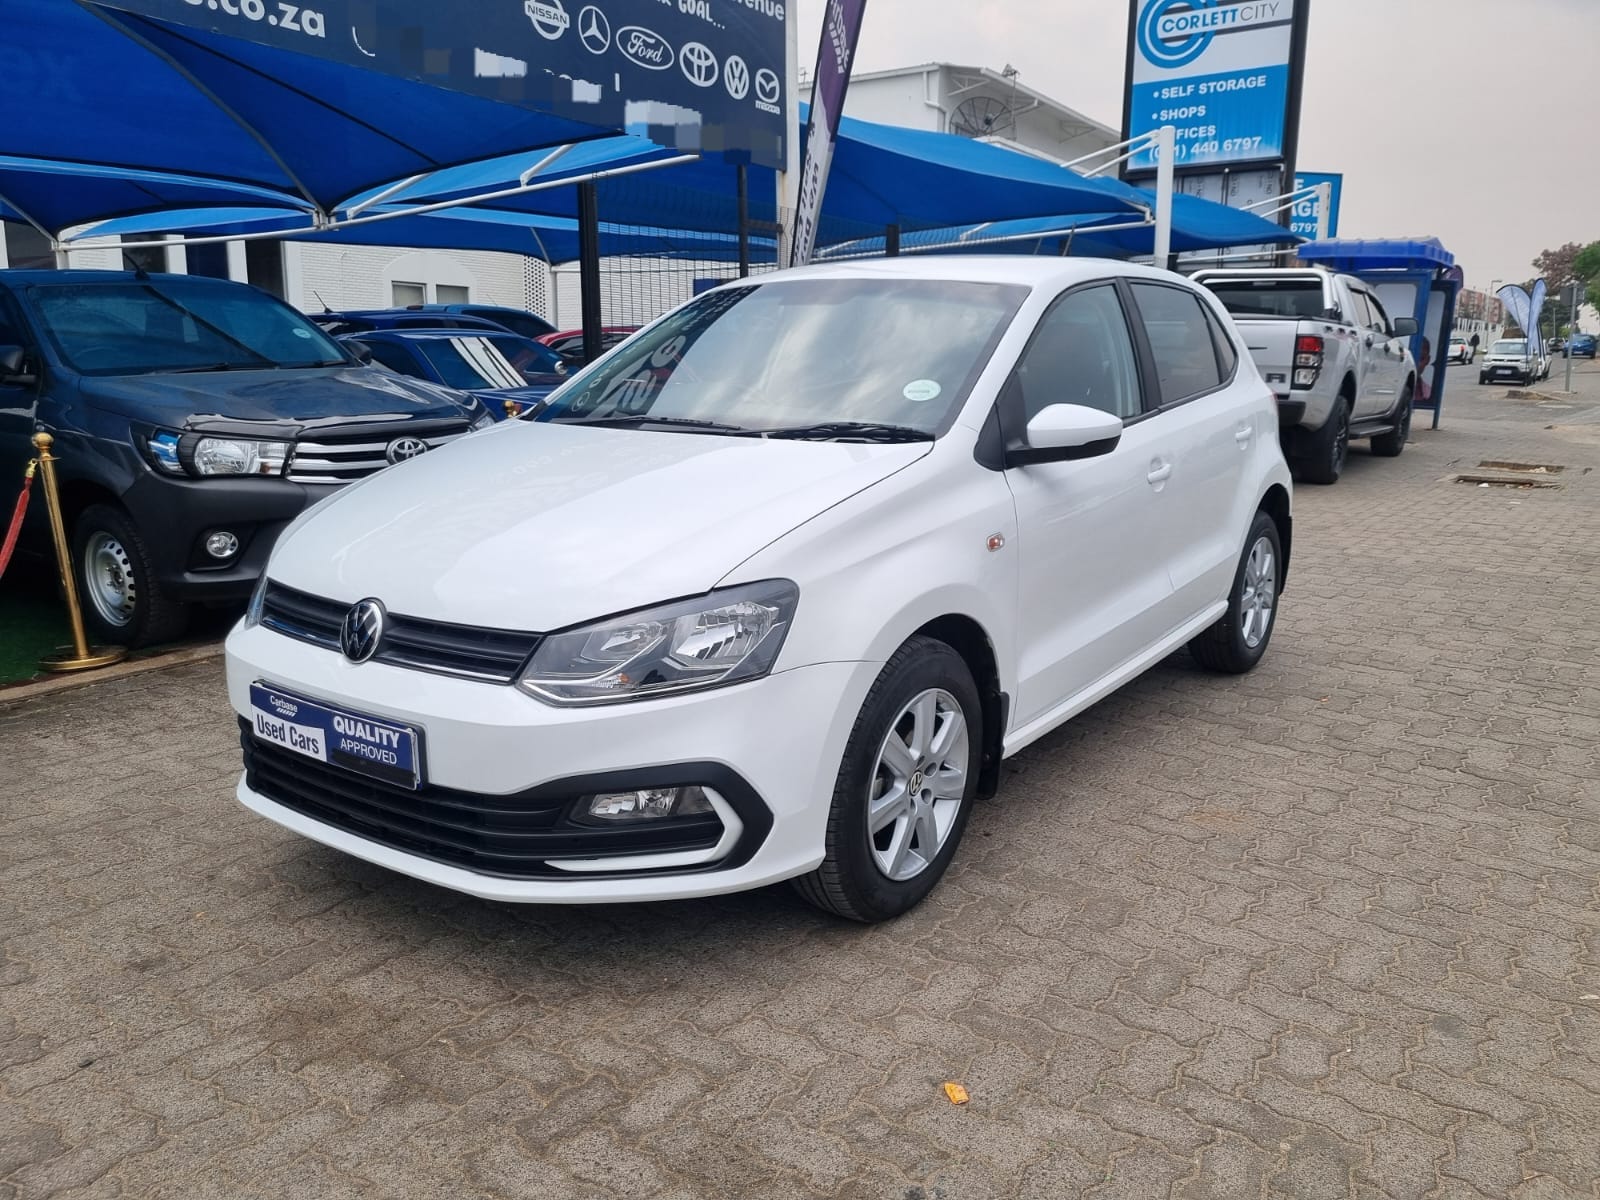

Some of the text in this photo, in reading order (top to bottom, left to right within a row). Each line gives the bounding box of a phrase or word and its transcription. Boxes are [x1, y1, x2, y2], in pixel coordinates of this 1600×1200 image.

[184, 0, 326, 38] .co.za
[527, 4, 567, 25] NISSAN
[628, 31, 664, 63] Ford
[1161, 75, 1267, 99] SELF STORAGE
[1160, 105, 1206, 121] SHOPS
[1175, 125, 1216, 140] FICES
[1191, 141, 1219, 154] 440
[1223, 136, 1262, 151] 6797
[1290, 222, 1317, 233] 6797
[270, 695, 298, 713] Carbase
[256, 713, 320, 754] Used Cars
[333, 715, 400, 749] QUALITY
[340, 738, 398, 765] APPROVED
